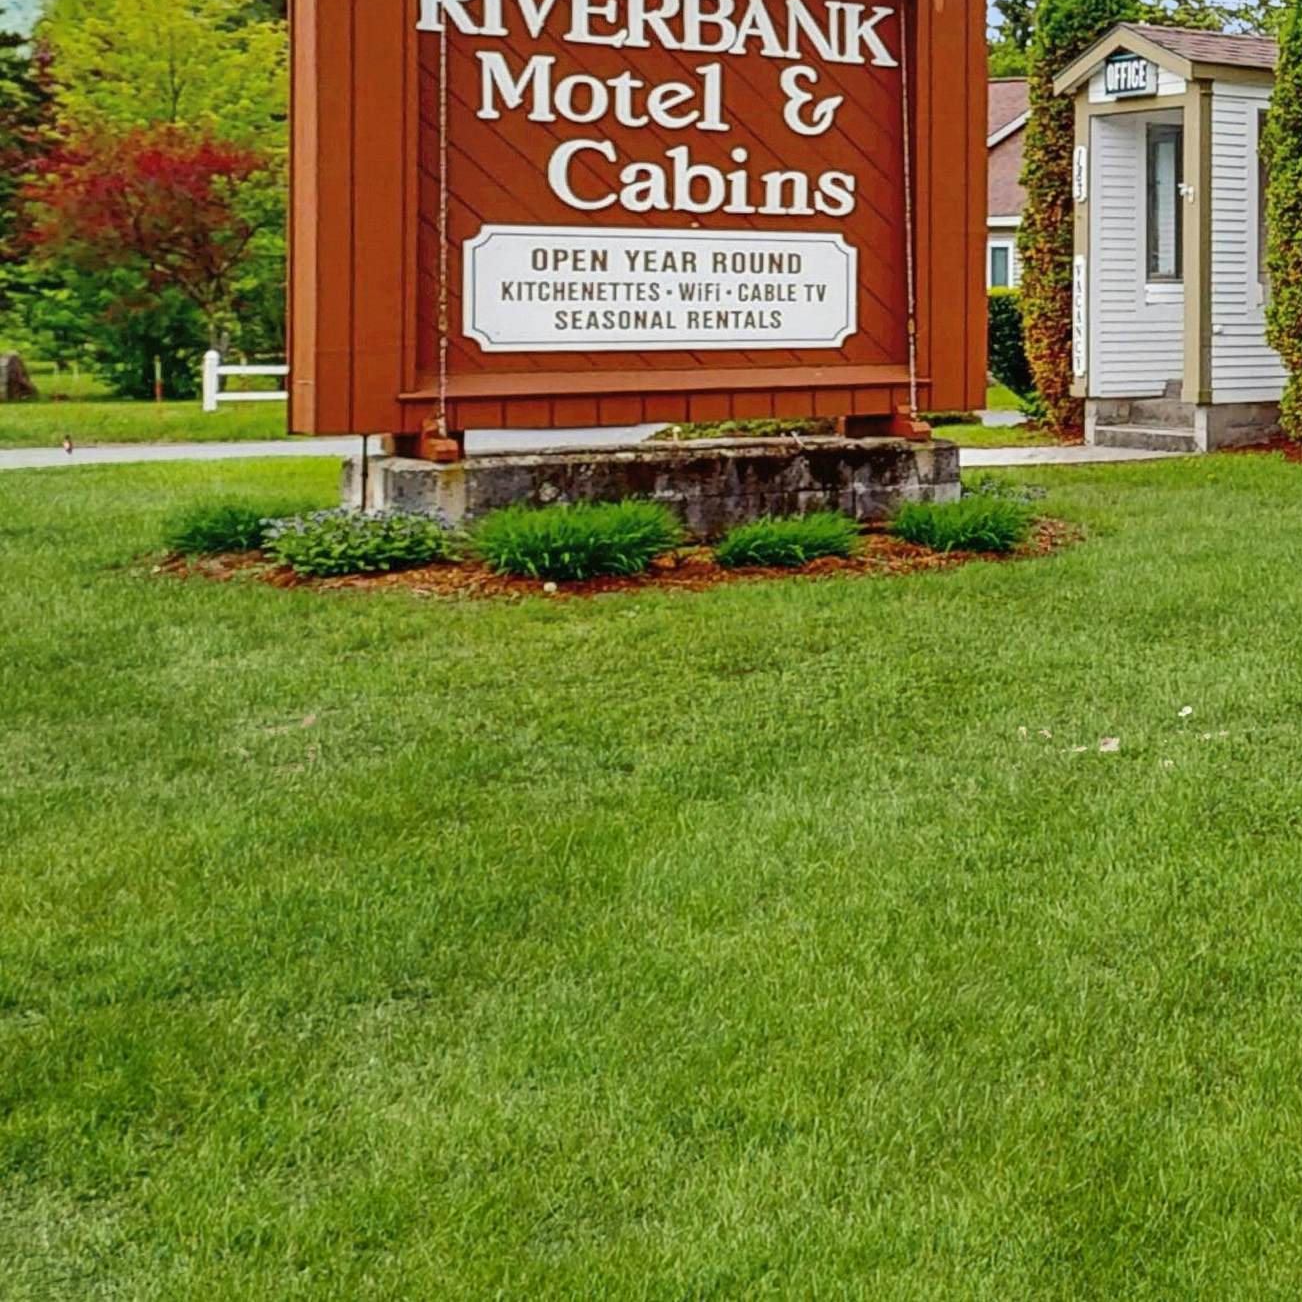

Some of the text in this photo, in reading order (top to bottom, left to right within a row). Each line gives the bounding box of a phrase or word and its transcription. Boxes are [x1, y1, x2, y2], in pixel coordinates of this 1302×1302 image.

[1106, 59, 1147, 91] OFFICE
[475, 50, 844, 136] Motel &
[547, 138, 856, 217] Cabins
[531, 247, 802, 275] OPEN YEAR ROUND
[501, 281, 827, 302] KITCHENETTES WiFi CABLE TV
[554, 310, 782, 330] SEASONAL RENTALS
